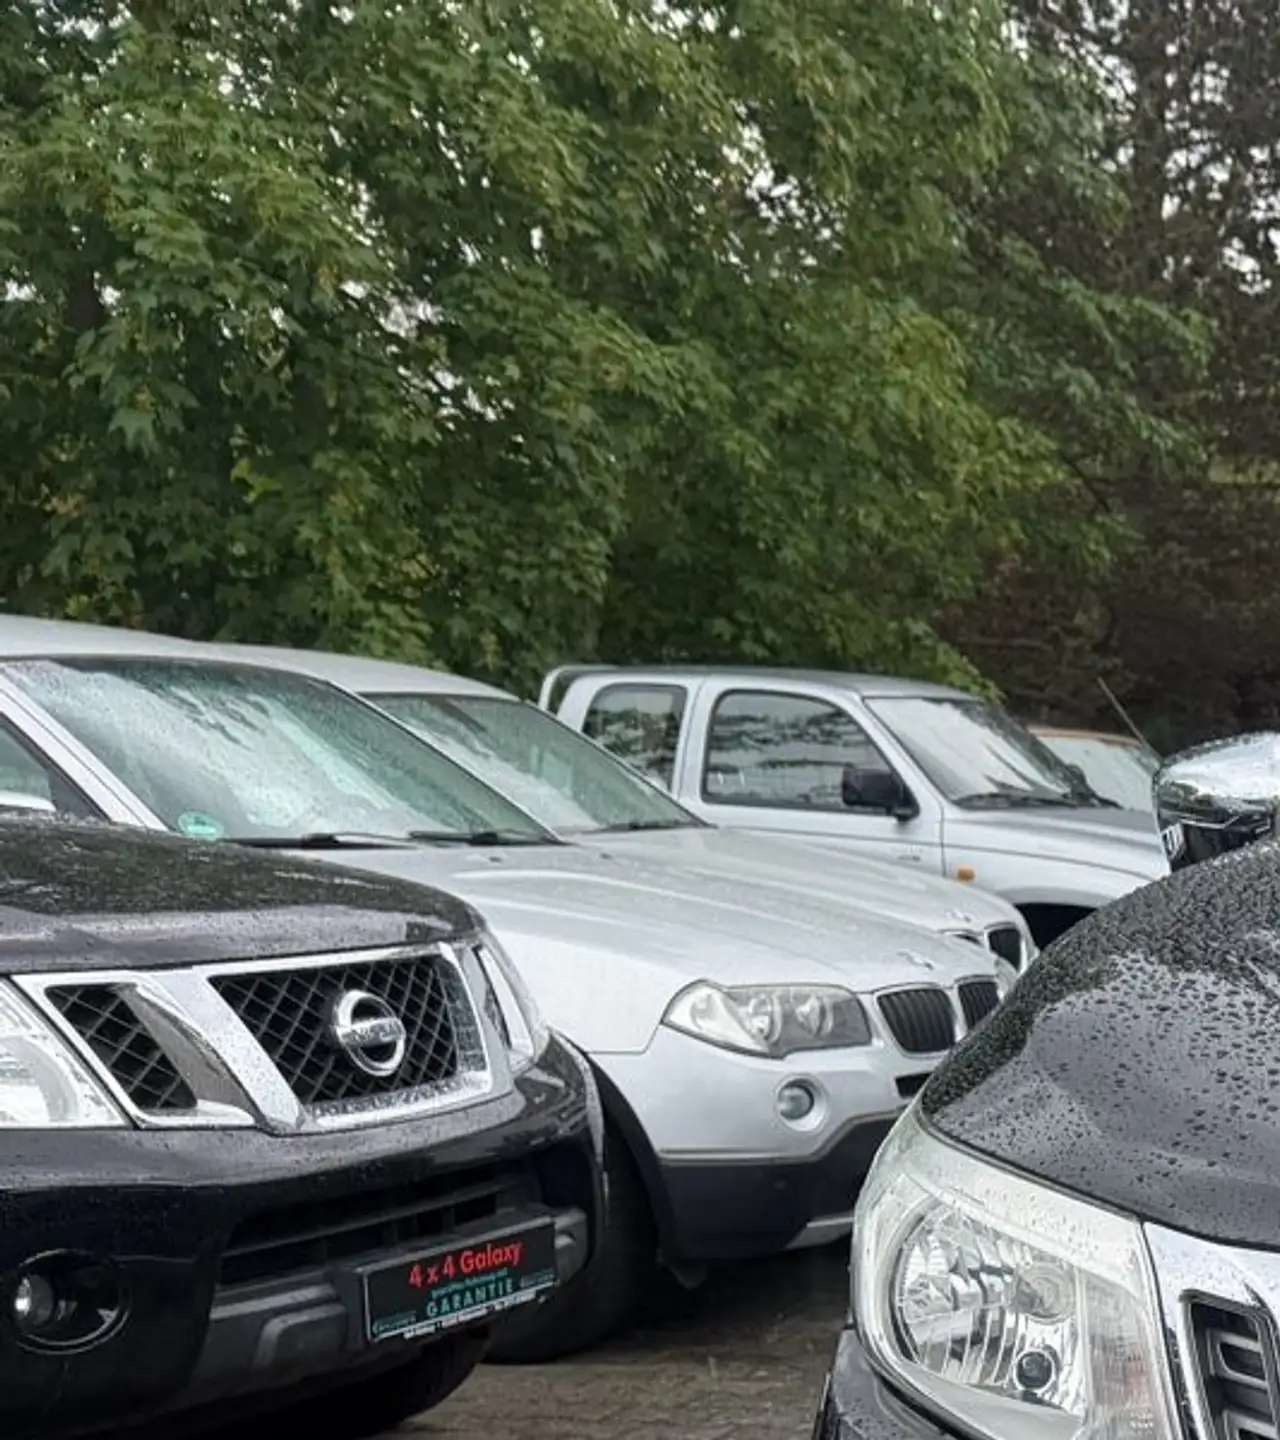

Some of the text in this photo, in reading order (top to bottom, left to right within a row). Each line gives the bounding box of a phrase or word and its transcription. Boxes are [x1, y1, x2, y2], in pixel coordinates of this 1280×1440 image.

[408, 1264, 423, 1289] 4
[443, 1256, 457, 1278] 4
[459, 1240, 524, 1274] Galaxy
[426, 1278, 514, 1318] GARANTIE
